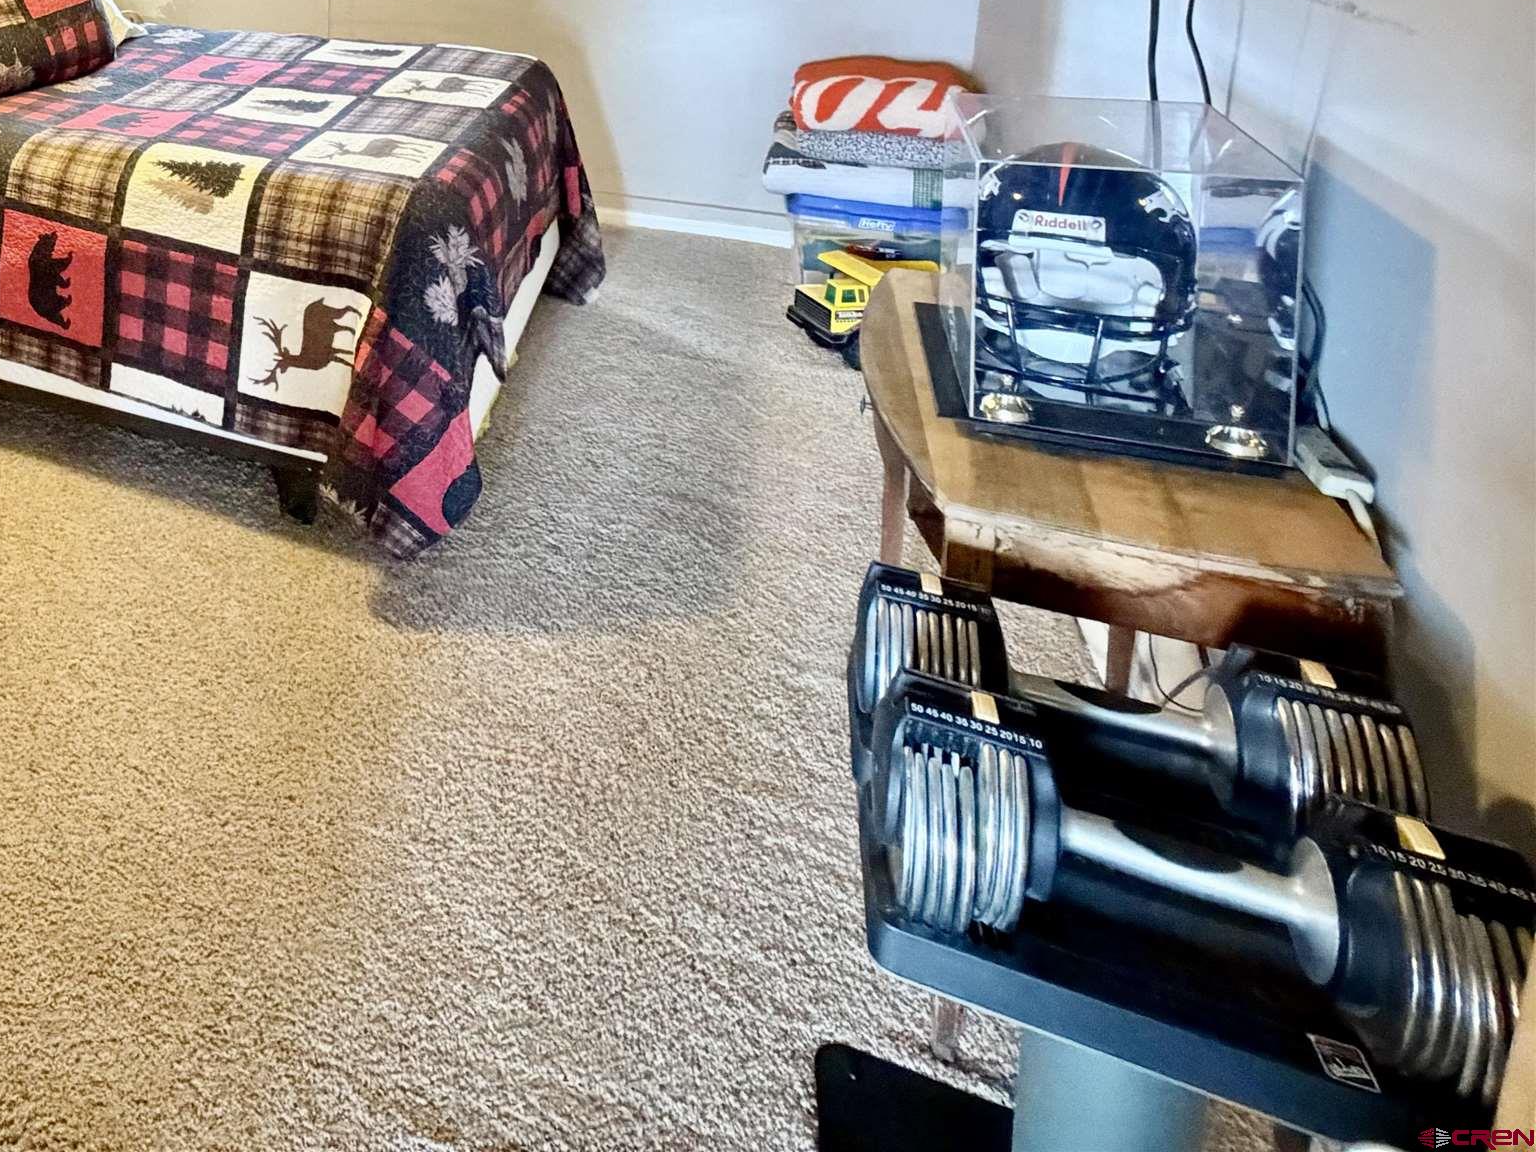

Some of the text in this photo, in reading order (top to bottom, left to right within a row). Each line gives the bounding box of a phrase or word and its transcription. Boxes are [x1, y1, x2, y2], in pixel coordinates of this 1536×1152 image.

[1034, 214, 1087, 230] Riddell
[881, 584, 892, 592] 50
[930, 596, 941, 604] 30
[943, 598, 954, 606] 25
[955, 600, 966, 609] 20
[967, 603, 977, 612] 15
[1258, 673, 1272, 683] 10
[1274, 678, 1288, 688] 15
[1288, 681, 1303, 691] 20
[911, 702, 1042, 748] 50 45 40 35 30 25 20 15 10
[1371, 843, 1388, 856] 10
[1389, 850, 1407, 863] 15
[1408, 855, 1427, 869] 20
[1428, 861, 1447, 876] 25
[1447, 866, 1467, 881] 30
[1466, 872, 1488, 888] 35
[1488, 879, 1508, 894] 40
